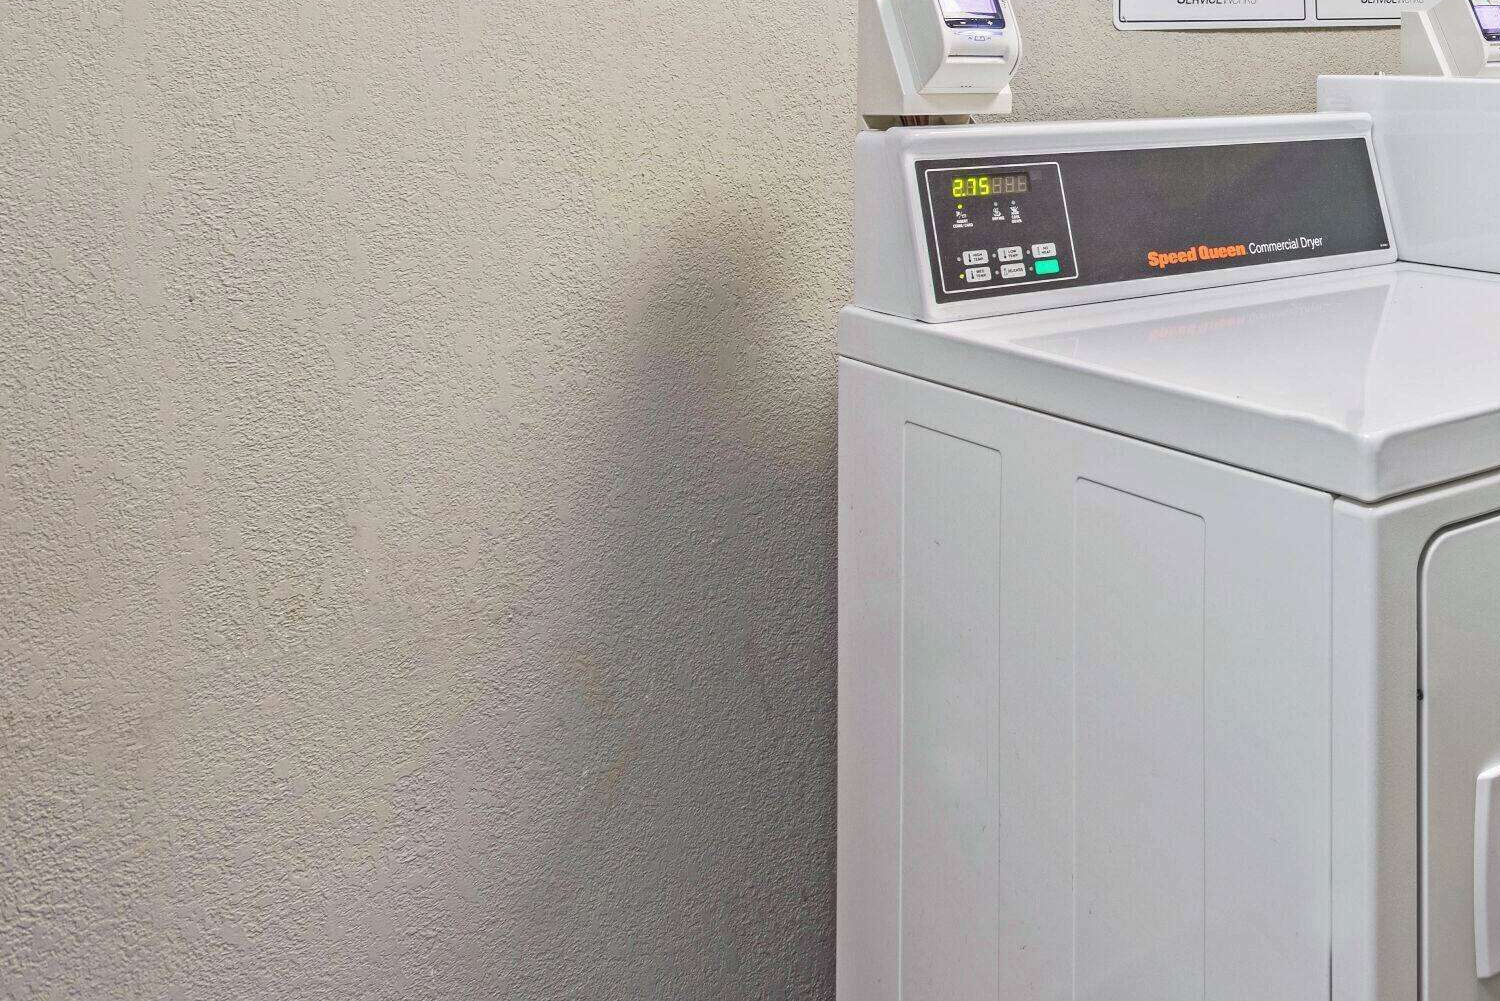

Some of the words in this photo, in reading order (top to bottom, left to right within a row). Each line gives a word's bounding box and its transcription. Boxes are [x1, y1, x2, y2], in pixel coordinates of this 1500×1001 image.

[952, 176, 990, 197] 2.75
[1147, 247, 1198, 268] Speed
[1198, 243, 1246, 262] Queen
[1248, 238, 1300, 254] Commercial
[1300, 236, 1324, 250] Dryer
